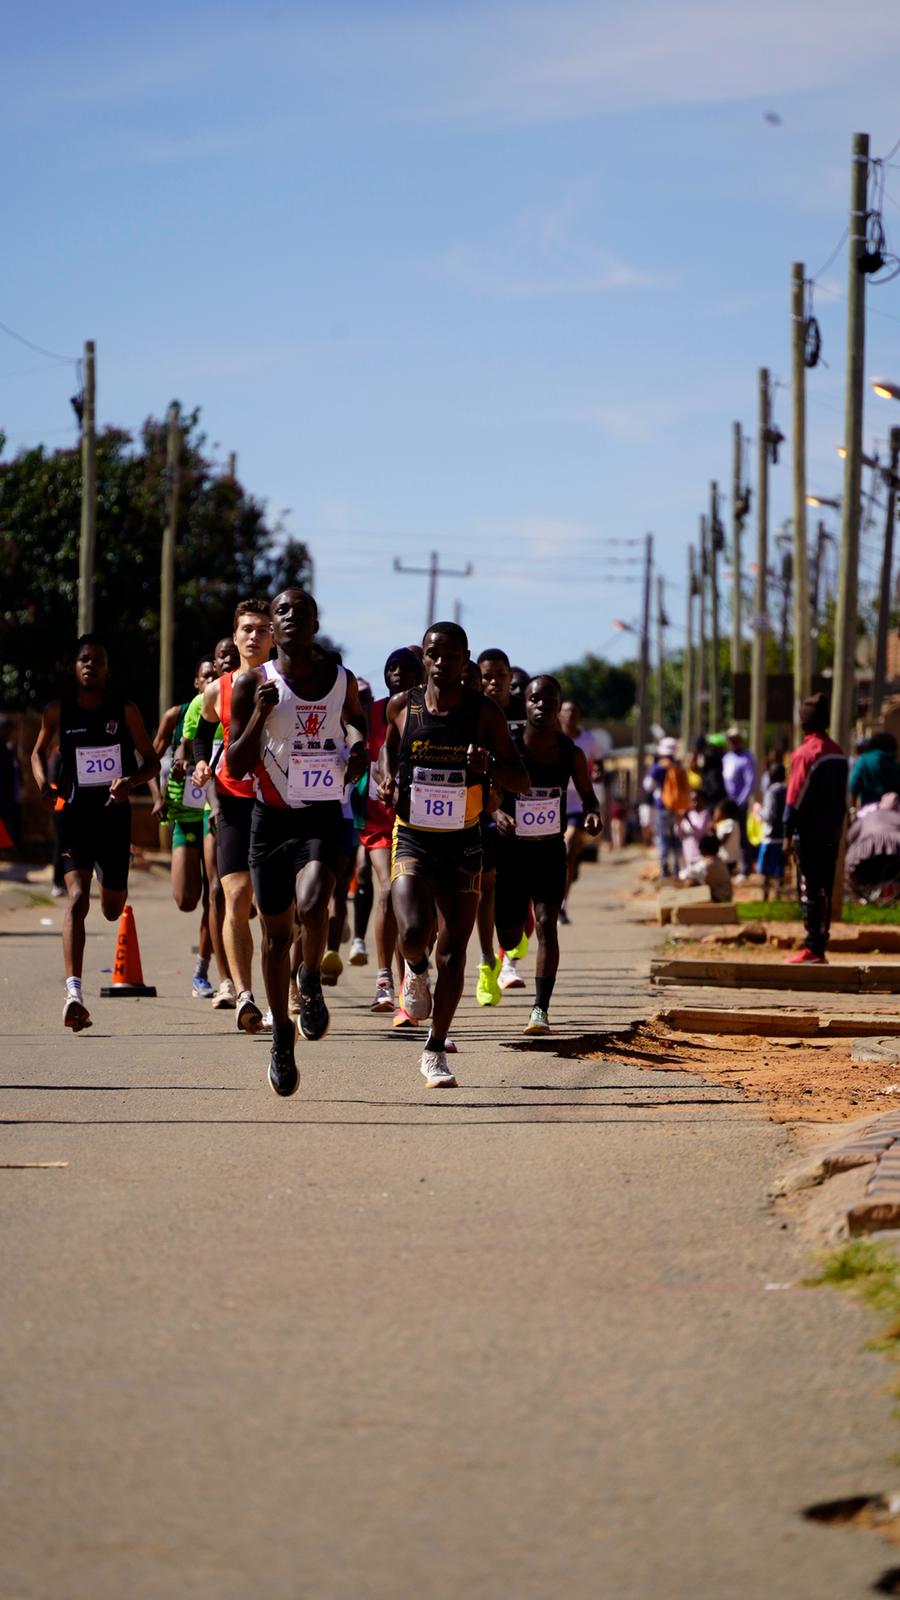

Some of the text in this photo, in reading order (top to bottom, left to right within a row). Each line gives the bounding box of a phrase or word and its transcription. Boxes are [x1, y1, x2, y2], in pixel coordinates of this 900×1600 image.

[86, 758, 115, 773] 210
[302, 770, 334, 787] 176
[425, 799, 453, 816] 181
[523, 810, 556, 825] 069
